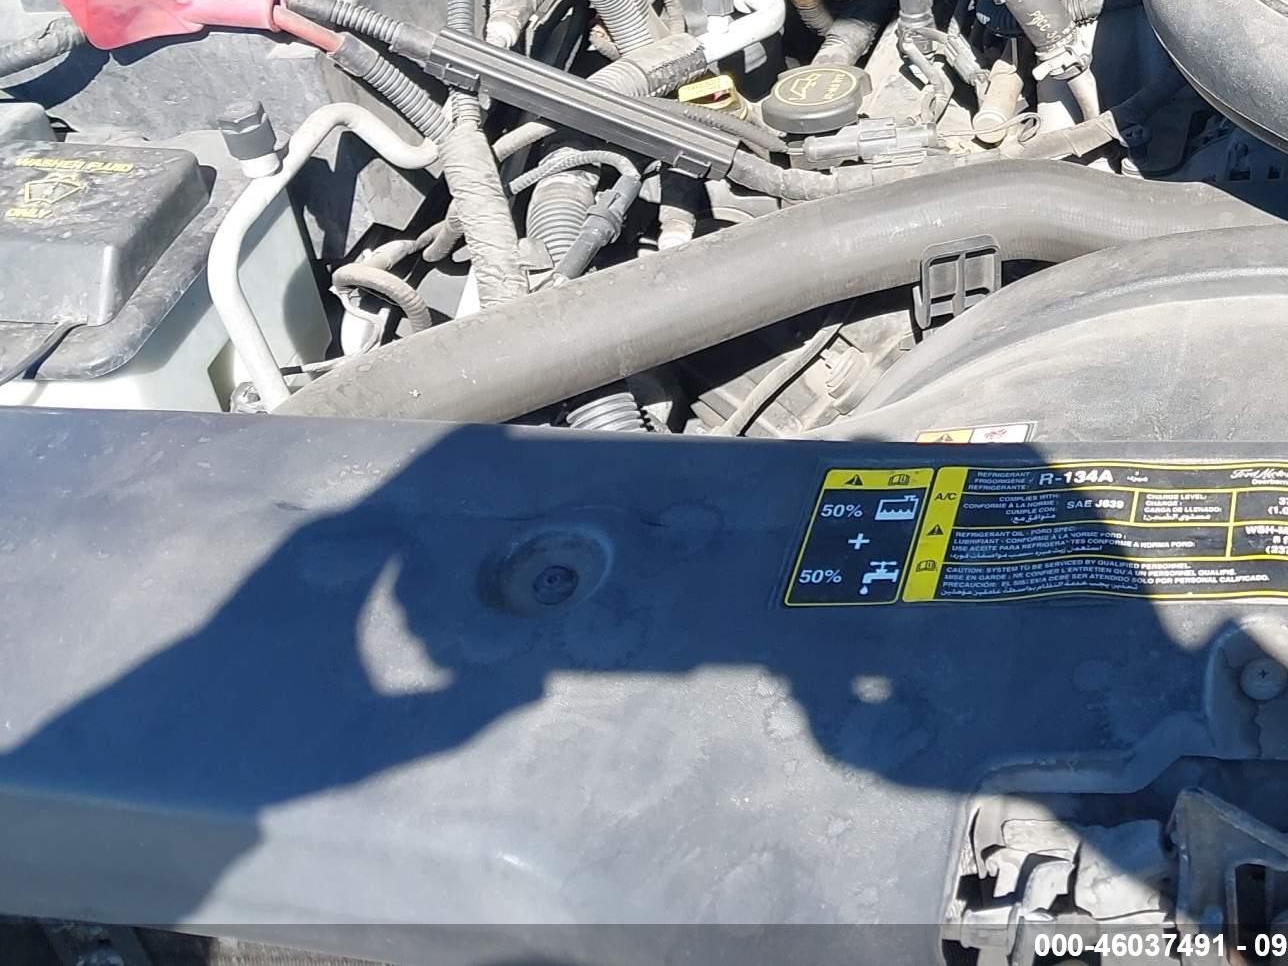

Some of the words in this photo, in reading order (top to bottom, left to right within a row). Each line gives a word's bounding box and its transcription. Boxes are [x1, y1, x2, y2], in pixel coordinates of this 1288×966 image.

[15, 157, 85, 171] WASHER
[86, 162, 134, 173] FLUID
[5, 207, 52, 219] ONLY
[1038, 469, 1114, 486] R-134A
[1230, 468, 1262, 480] Ford
[934, 490, 958, 502] A/C
[999, 494, 1038, 502] COMPLIES
[820, 503, 863, 518] 50%
[963, 502, 1007, 510] CONFORME
[1026, 500, 1055, 508] NORME
[1066, 499, 1093, 510] SAE
[955, 530, 1010, 538] REFRIGERANT
[1030, 528, 1052, 536] FORD
[1006, 535, 1049, 544] CONFORME
[1058, 532, 1069, 540] LA
[1071, 531, 1099, 539] NORME
[1099, 531, 1123, 539] FORD
[969, 544, 998, 552] ACEITE
[999, 543, 1020, 551] PARA
[1087, 538, 1133, 548] CONFORME
[986, 565, 1019, 574] SYSTEM
[1044, 559, 1084, 569] SERVICED
[1097, 560, 1140, 569] QUALIFIED
[1025, 568, 1060, 578] CONFIER
[1061, 566, 1112, 574] L'ENTRETIEN
[1135, 569, 1147, 577] UN
[799, 569, 842, 584] 50%
[1048, 574, 1069, 582] DEBE
[1088, 573, 1130, 583] ATENDIDO
[1131, 576, 1154, 584] SOLO
[1174, 576, 1218, 584] PERSONAL
